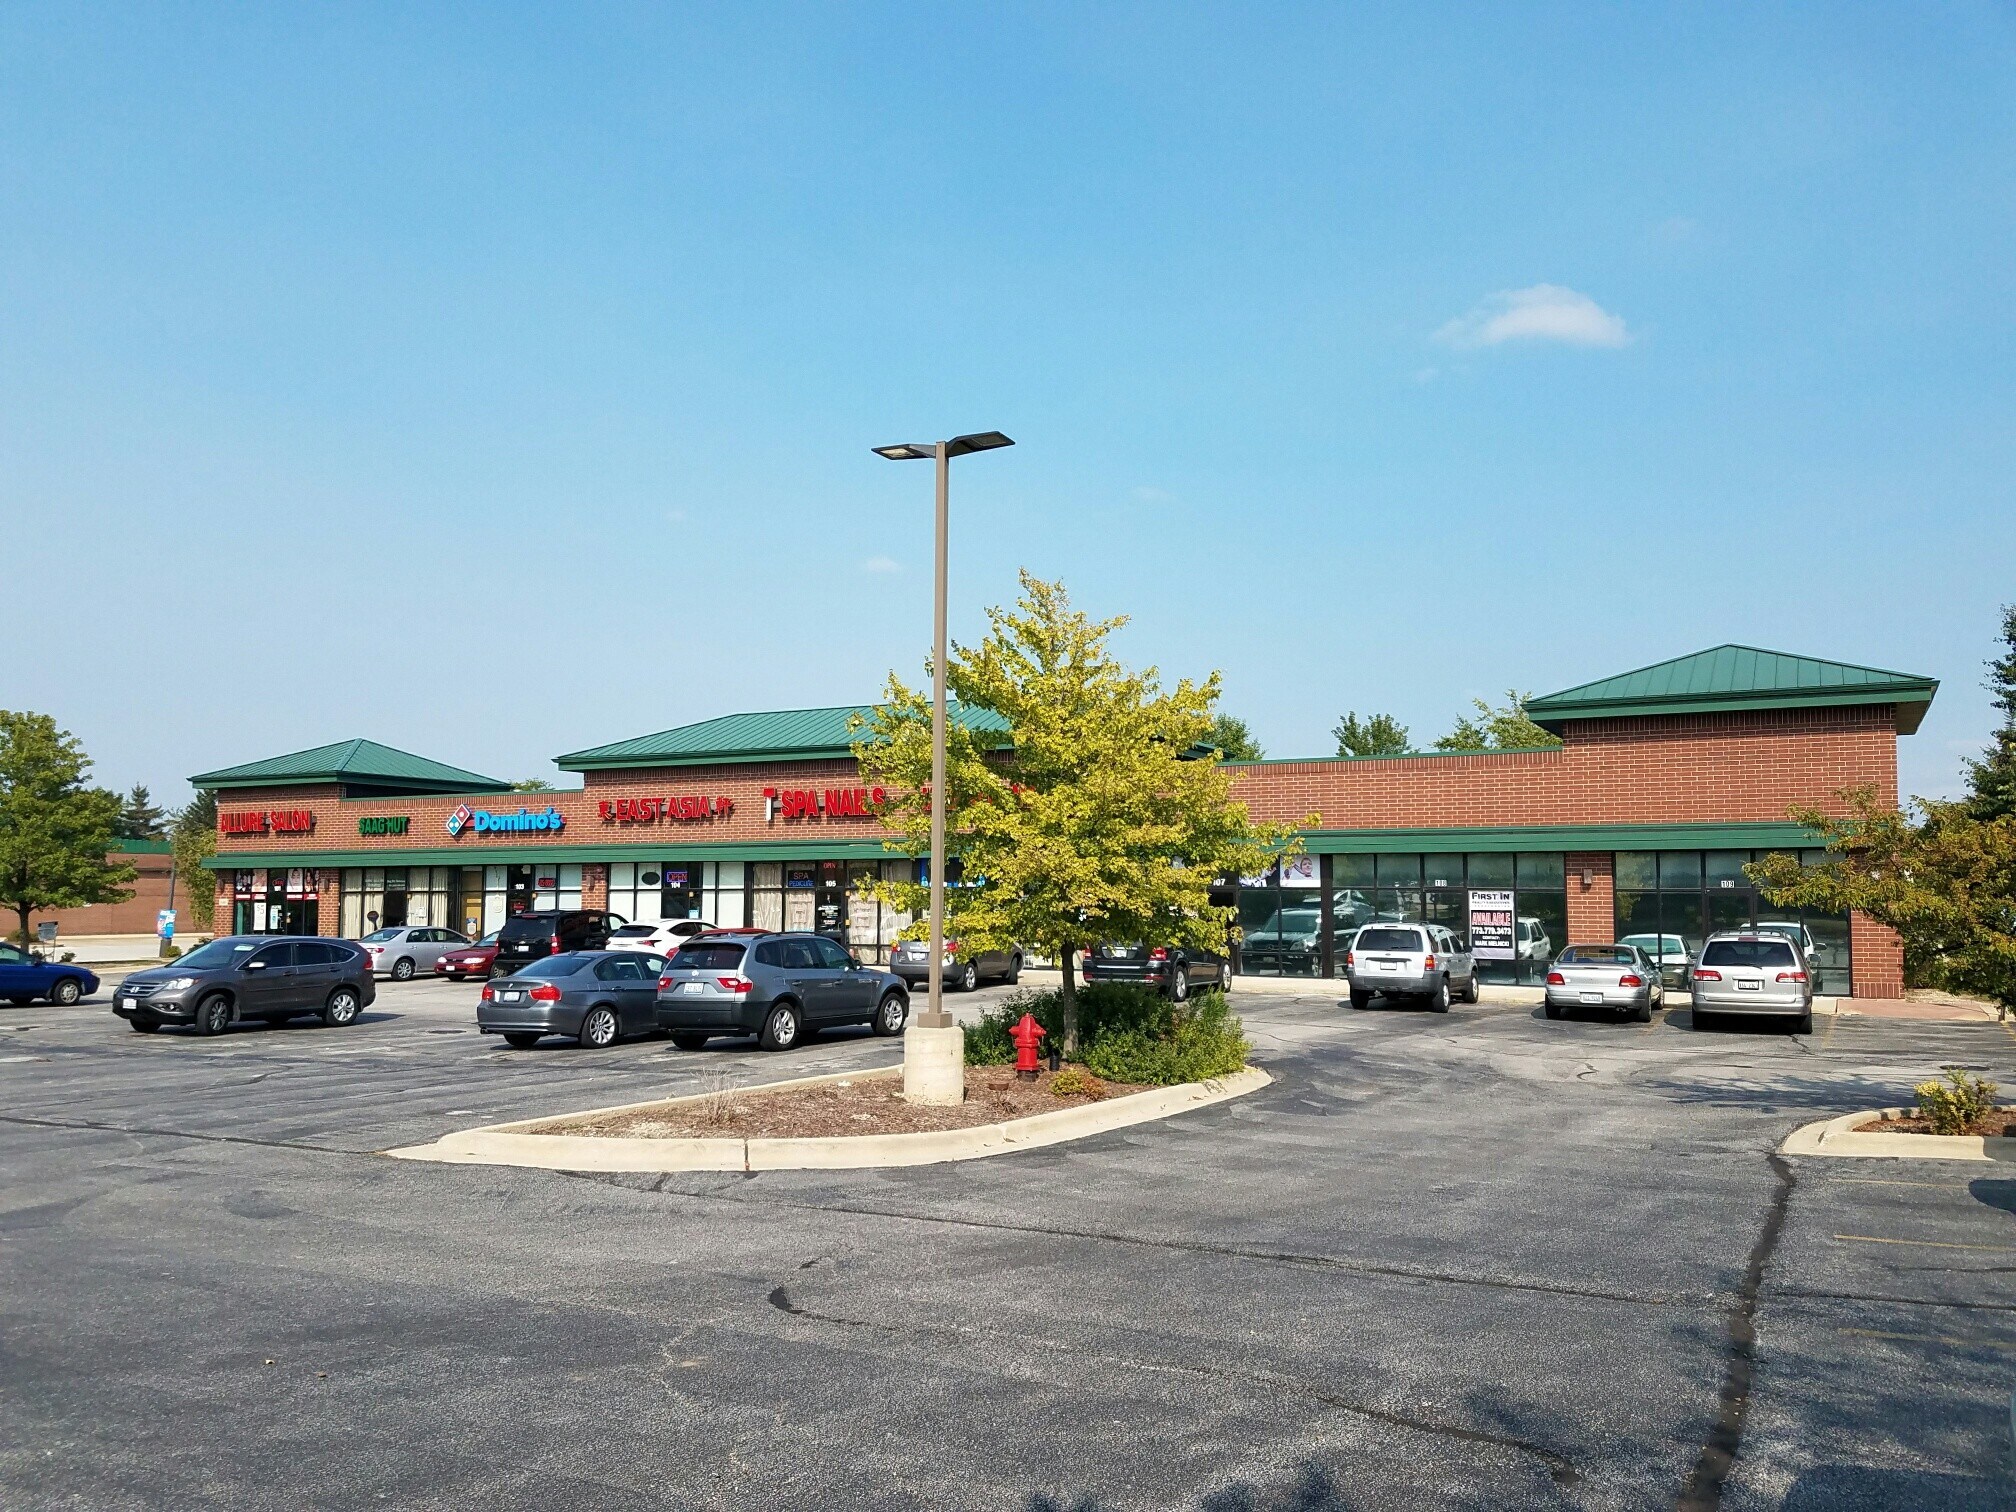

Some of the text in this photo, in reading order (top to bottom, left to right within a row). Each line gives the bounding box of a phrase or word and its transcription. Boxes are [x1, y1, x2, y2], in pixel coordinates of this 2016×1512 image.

[616, 797, 664, 820] EAST
[666, 796, 711, 819] ASIA
[781, 788, 819, 818] SPA
[824, 786, 886, 817] NAILS
[220, 810, 311, 833] ALLURE SALON
[358, 816, 408, 834] SAAG HUT
[474, 807, 562, 831] Domino's
[668, 872, 688, 882] OPEN
[793, 872, 809, 880] SPA
[1721, 880, 1735, 888] 109
[1471, 892, 1510, 900] FIRST IN
[1472, 912, 1511, 926] AVAILABLE
[1471, 927, 1512, 935] 773.779.3473
